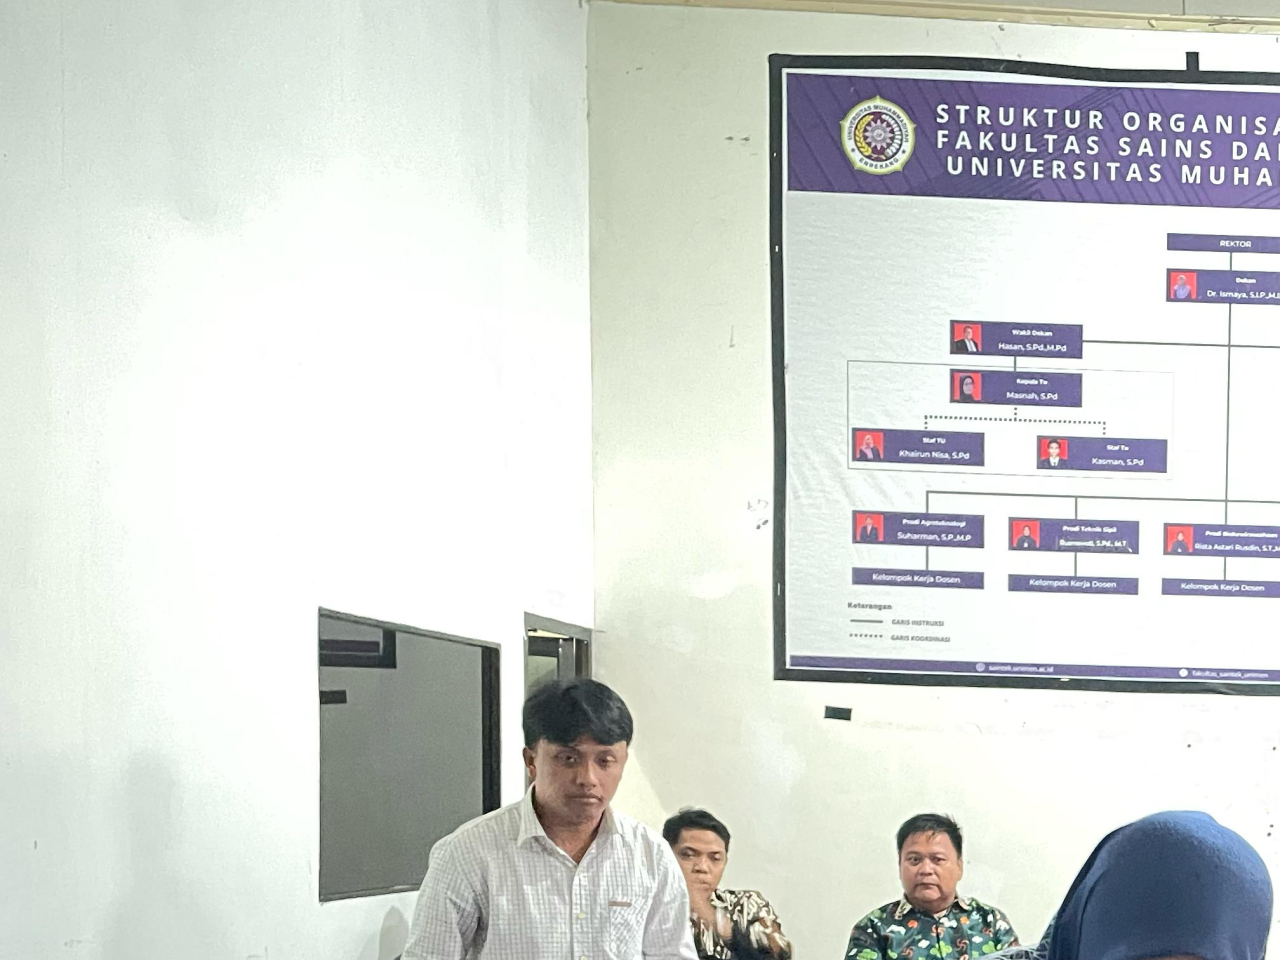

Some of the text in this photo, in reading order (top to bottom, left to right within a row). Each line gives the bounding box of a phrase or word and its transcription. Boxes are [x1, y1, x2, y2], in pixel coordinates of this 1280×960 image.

[936, 104, 1104, 130] STRUKTUR
[936, 129, 1100, 155] FAKULTAS
[1118, 136, 1213, 160] SAINS
[946, 156, 1163, 183] UNIVERSITAS
[1219, 240, 1252, 248] REKTOR
[1206, 290, 1218, 298] Dr.
[998, 342, 1025, 351] Hasan,
[899, 450, 931, 458] Khairun
[932, 451, 951, 459] Nisa,
[1092, 457, 1125, 466] Kasman,
[897, 531, 940, 541] Suharman,
[872, 573, 961, 584] Kelompok Kerja Dosen
[1029, 579, 1069, 588] Kelompok
[1070, 580, 1090, 588] Kerja
[1181, 582, 1265, 592] Kelompok Kerja Dosen
[847, 602, 893, 611] Keterangan
[911, 635, 951, 643] KOORDINASI
